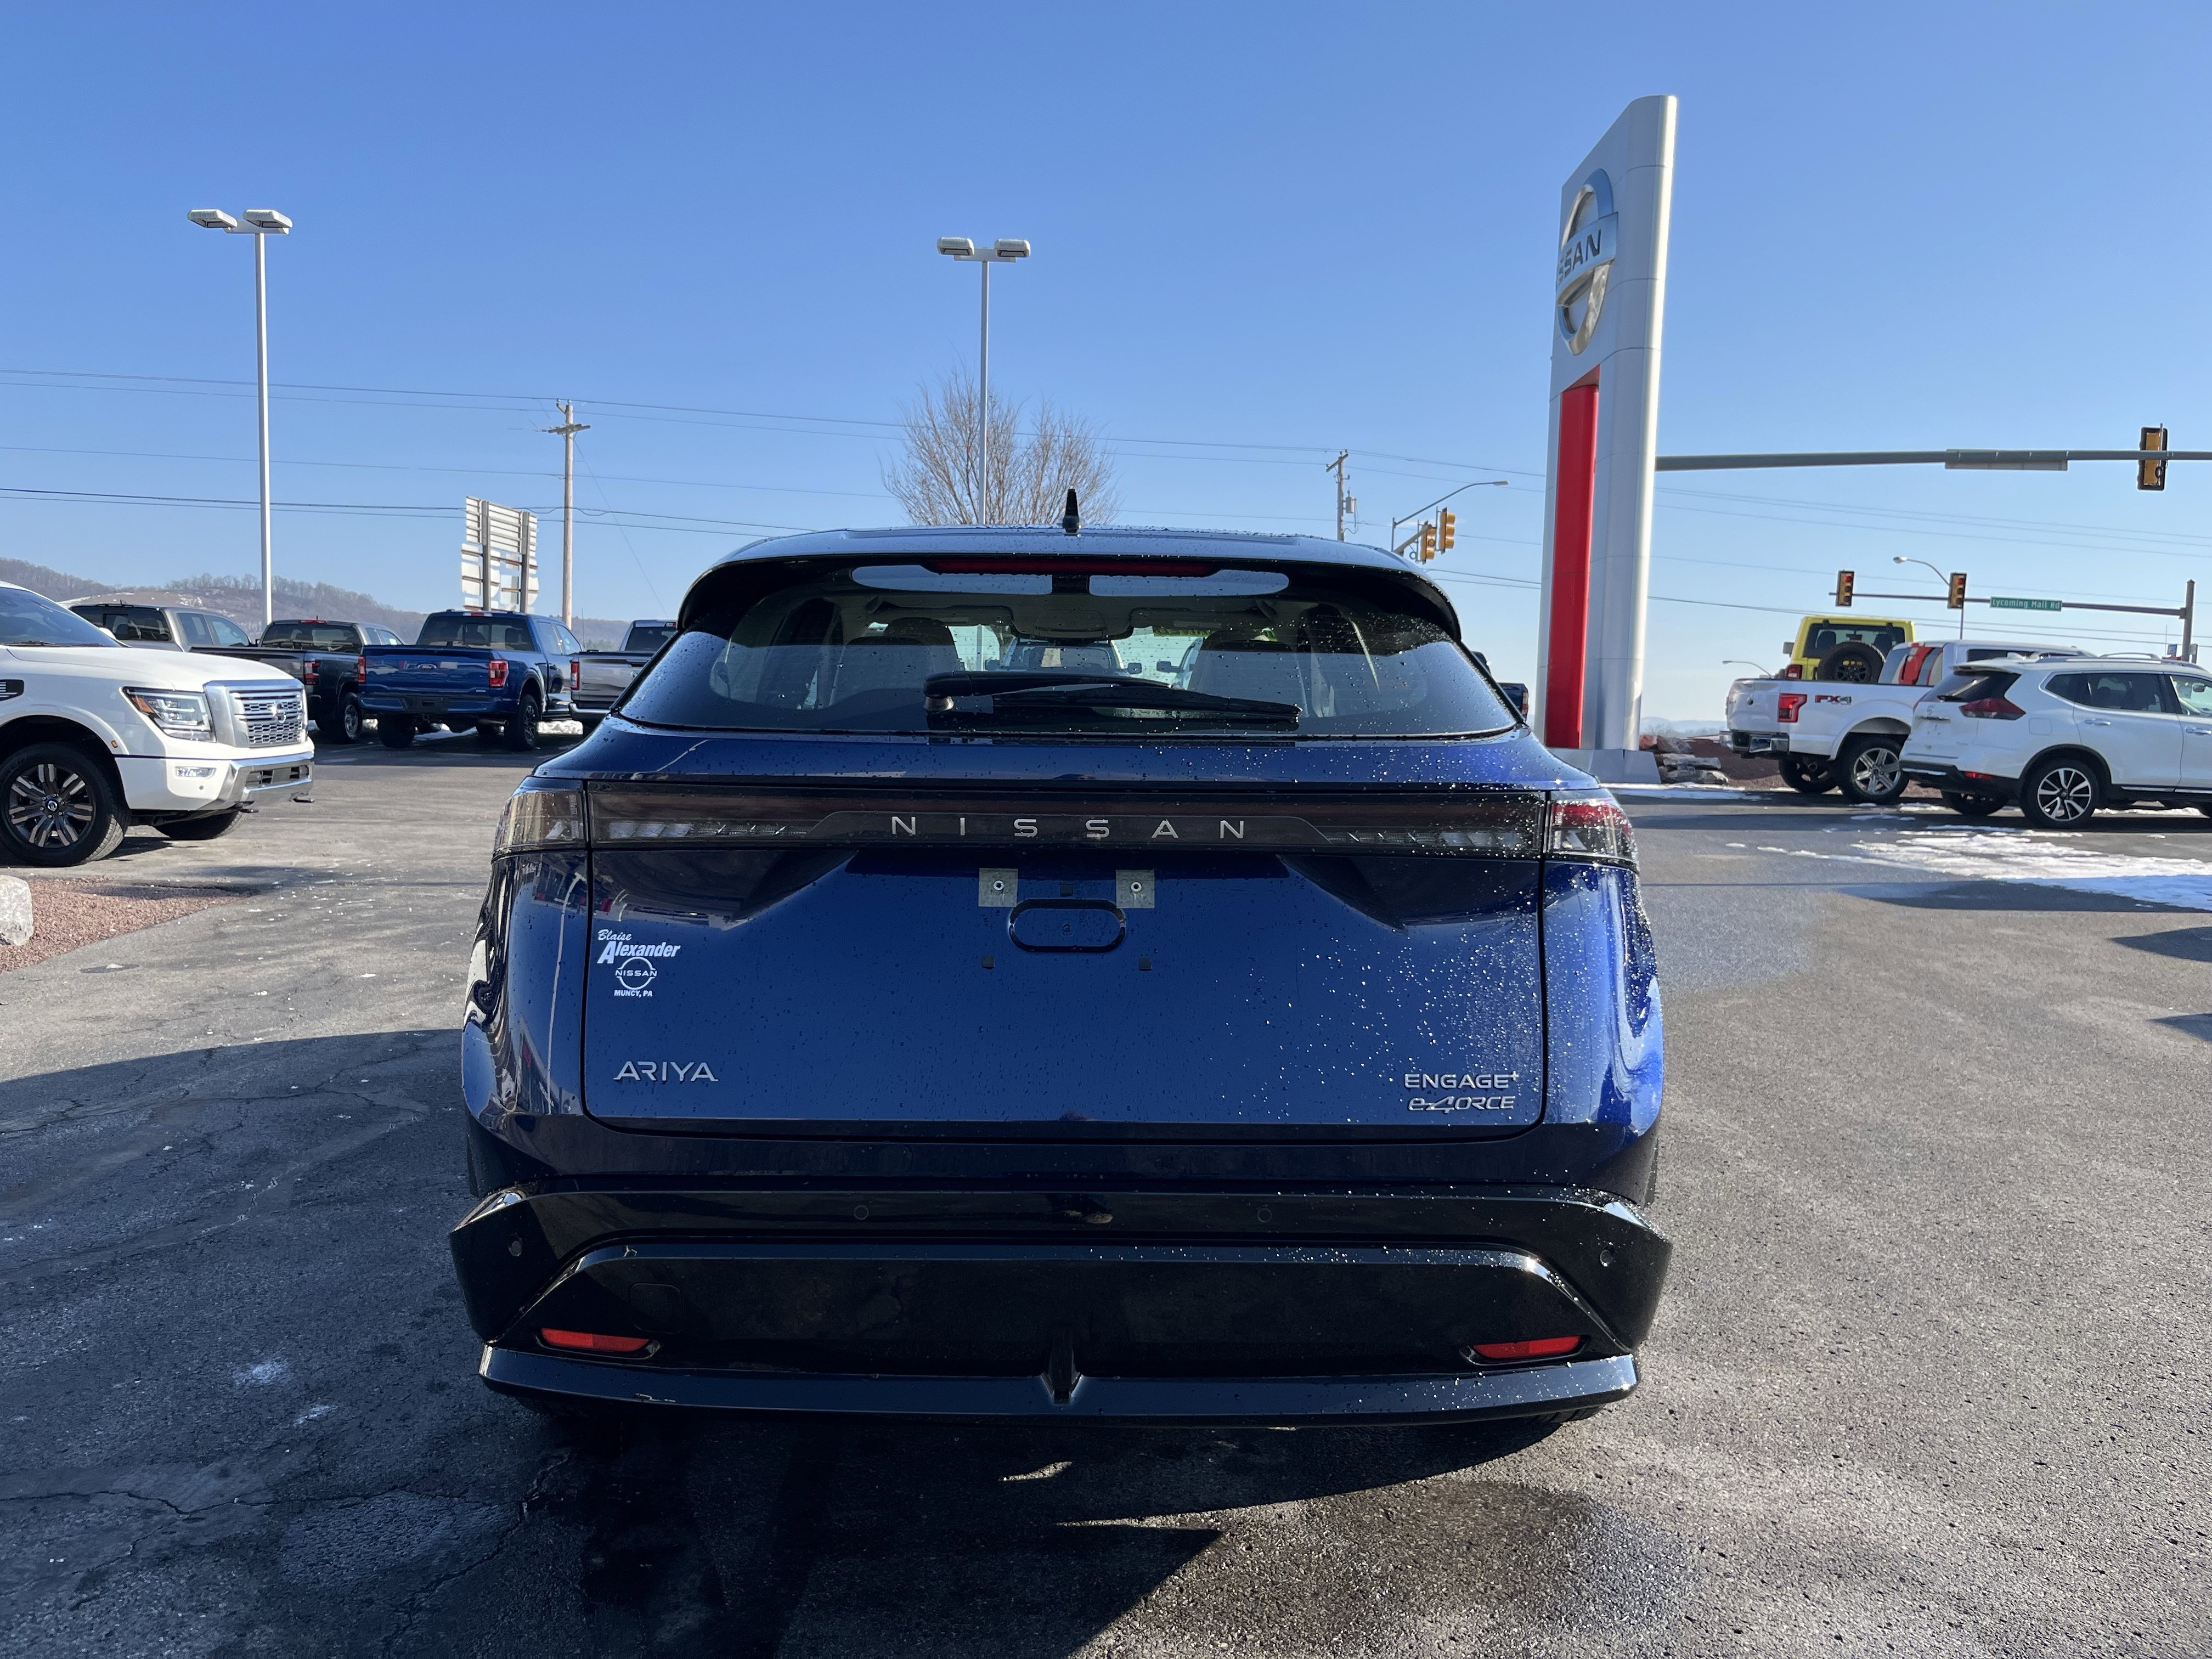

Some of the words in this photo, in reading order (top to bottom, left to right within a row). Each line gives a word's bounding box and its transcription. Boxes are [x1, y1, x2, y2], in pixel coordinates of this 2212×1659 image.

[1557, 229, 1601, 284] SSAN
[1993, 598, 2028, 609] Lycoming
[2032, 600, 2047, 608] Mall
[1815, 695, 1852, 706] FX4
[891, 816, 1244, 839] NISSAN
[597, 929, 632, 941] Blaise
[597, 941, 681, 964] Alexander
[614, 989, 642, 998] MUNCY,
[613, 1060, 719, 1082] ARIYA
